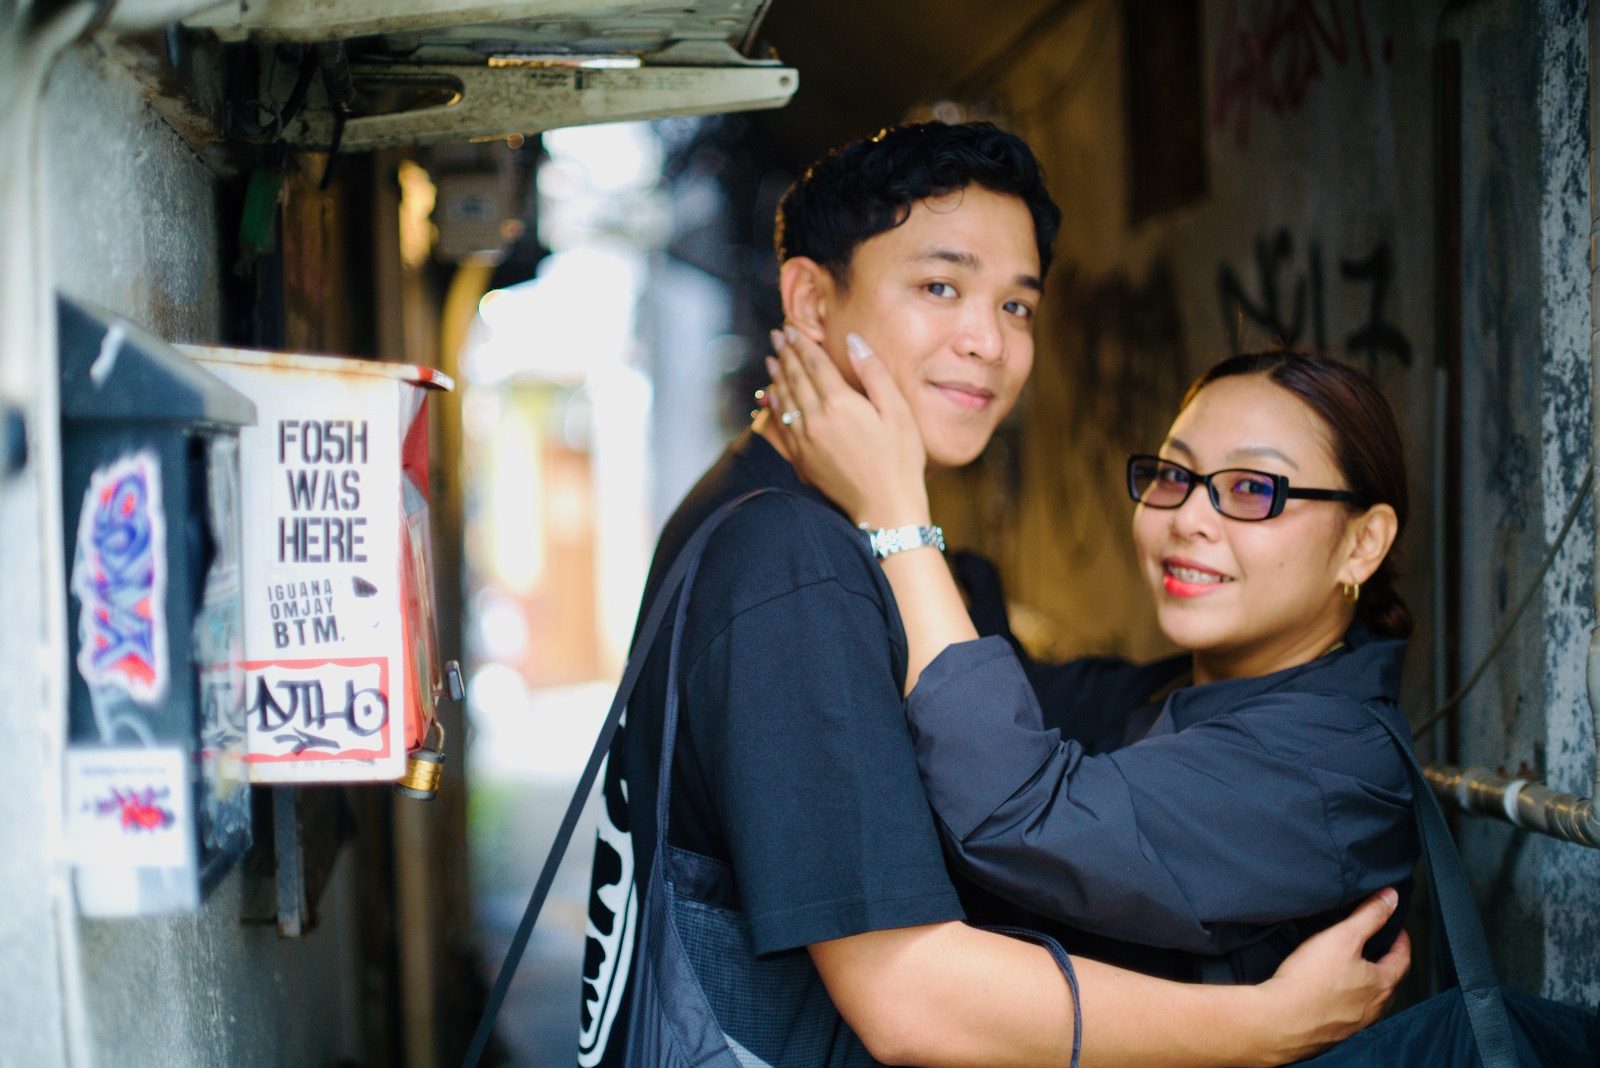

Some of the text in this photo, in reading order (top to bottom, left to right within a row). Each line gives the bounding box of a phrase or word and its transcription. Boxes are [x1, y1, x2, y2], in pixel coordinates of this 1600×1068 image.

[286, 469, 360, 511] WAS
[278, 517, 367, 562] HERE
[267, 579, 333, 602] IGUANA
[269, 596, 333, 620] OMJAY
[273, 615, 345, 649] BTM.
